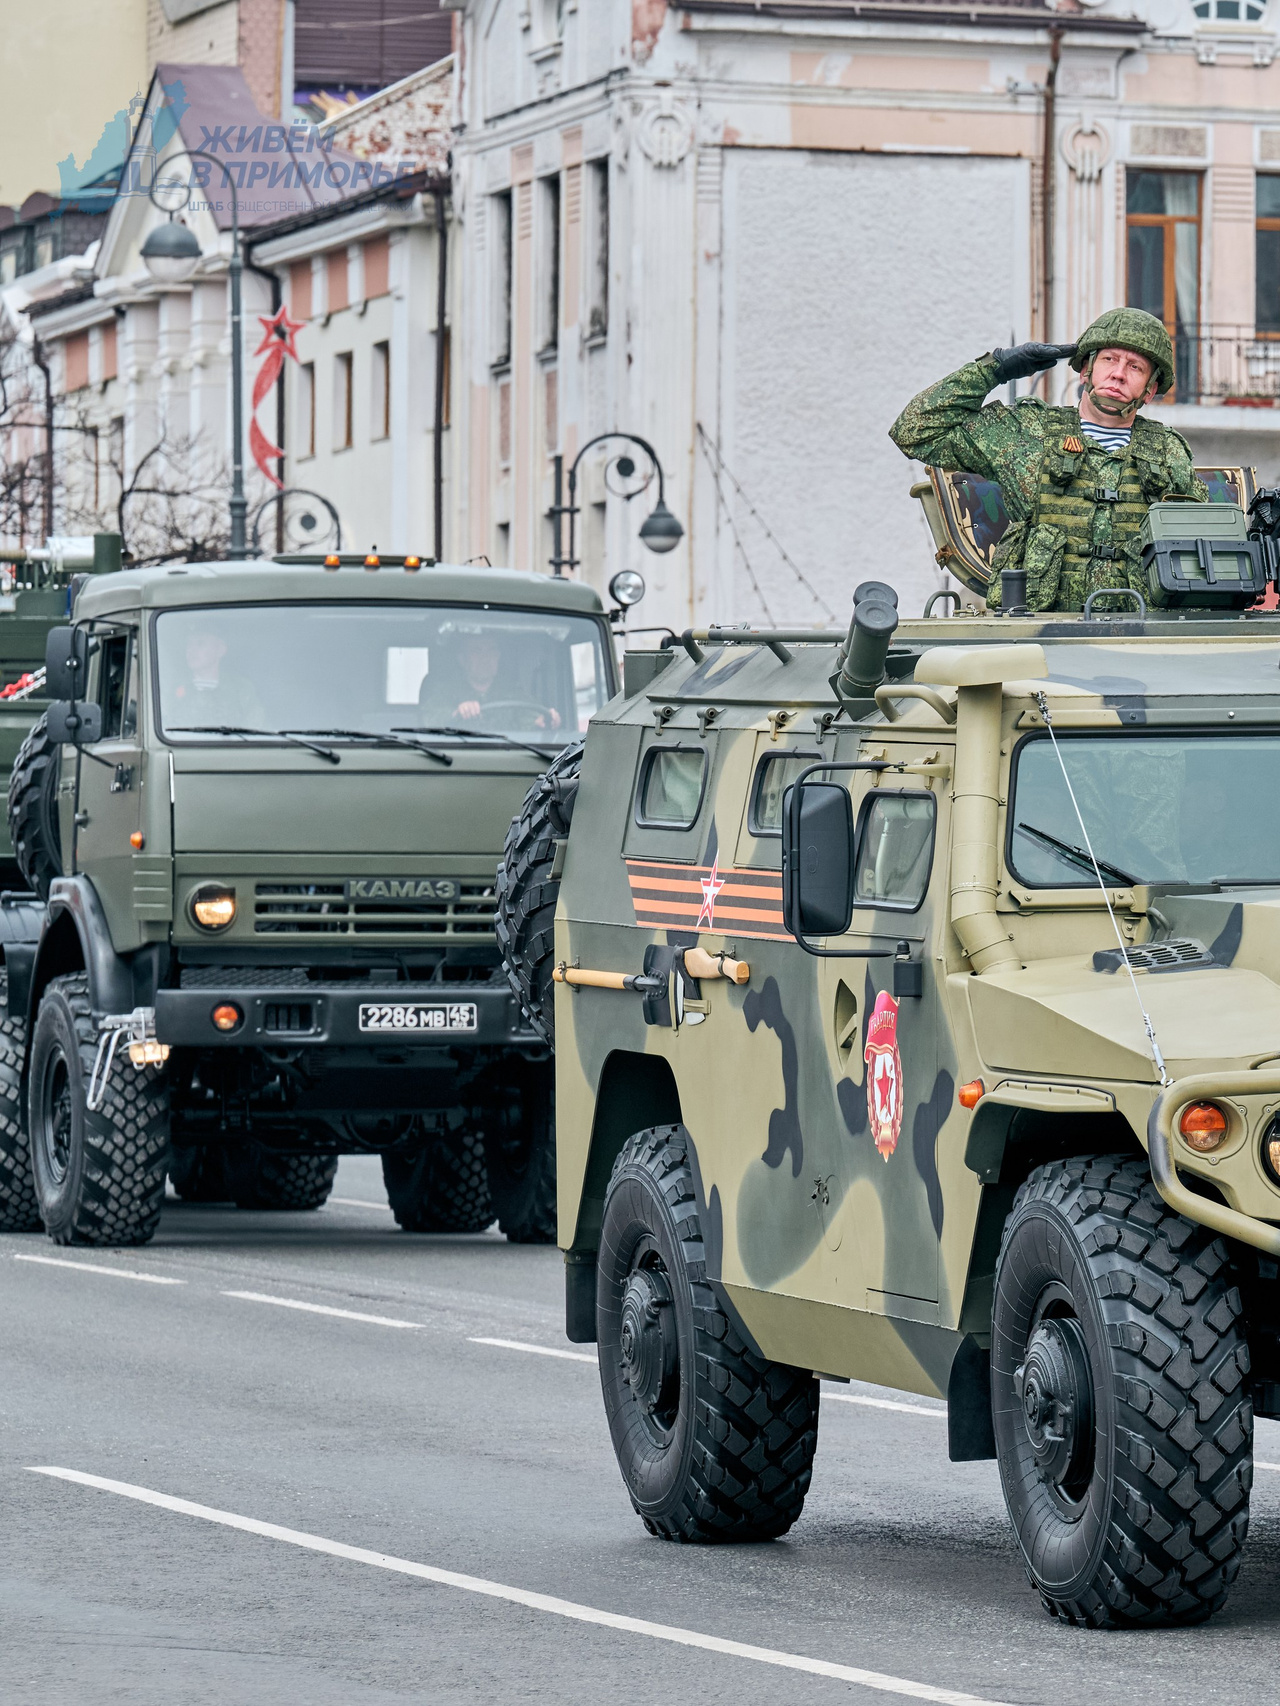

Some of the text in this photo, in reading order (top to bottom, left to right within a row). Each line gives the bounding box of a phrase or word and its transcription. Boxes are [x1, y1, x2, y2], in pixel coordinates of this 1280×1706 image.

[350, 881, 455, 898] КАМАЗ
[367, 1006, 418, 1028] 2286
[420, 1010, 446, 1027] МВ
[450, 1005, 470, 1021] 45
[870, 1010, 896, 1038] ГВАРДИЯ
